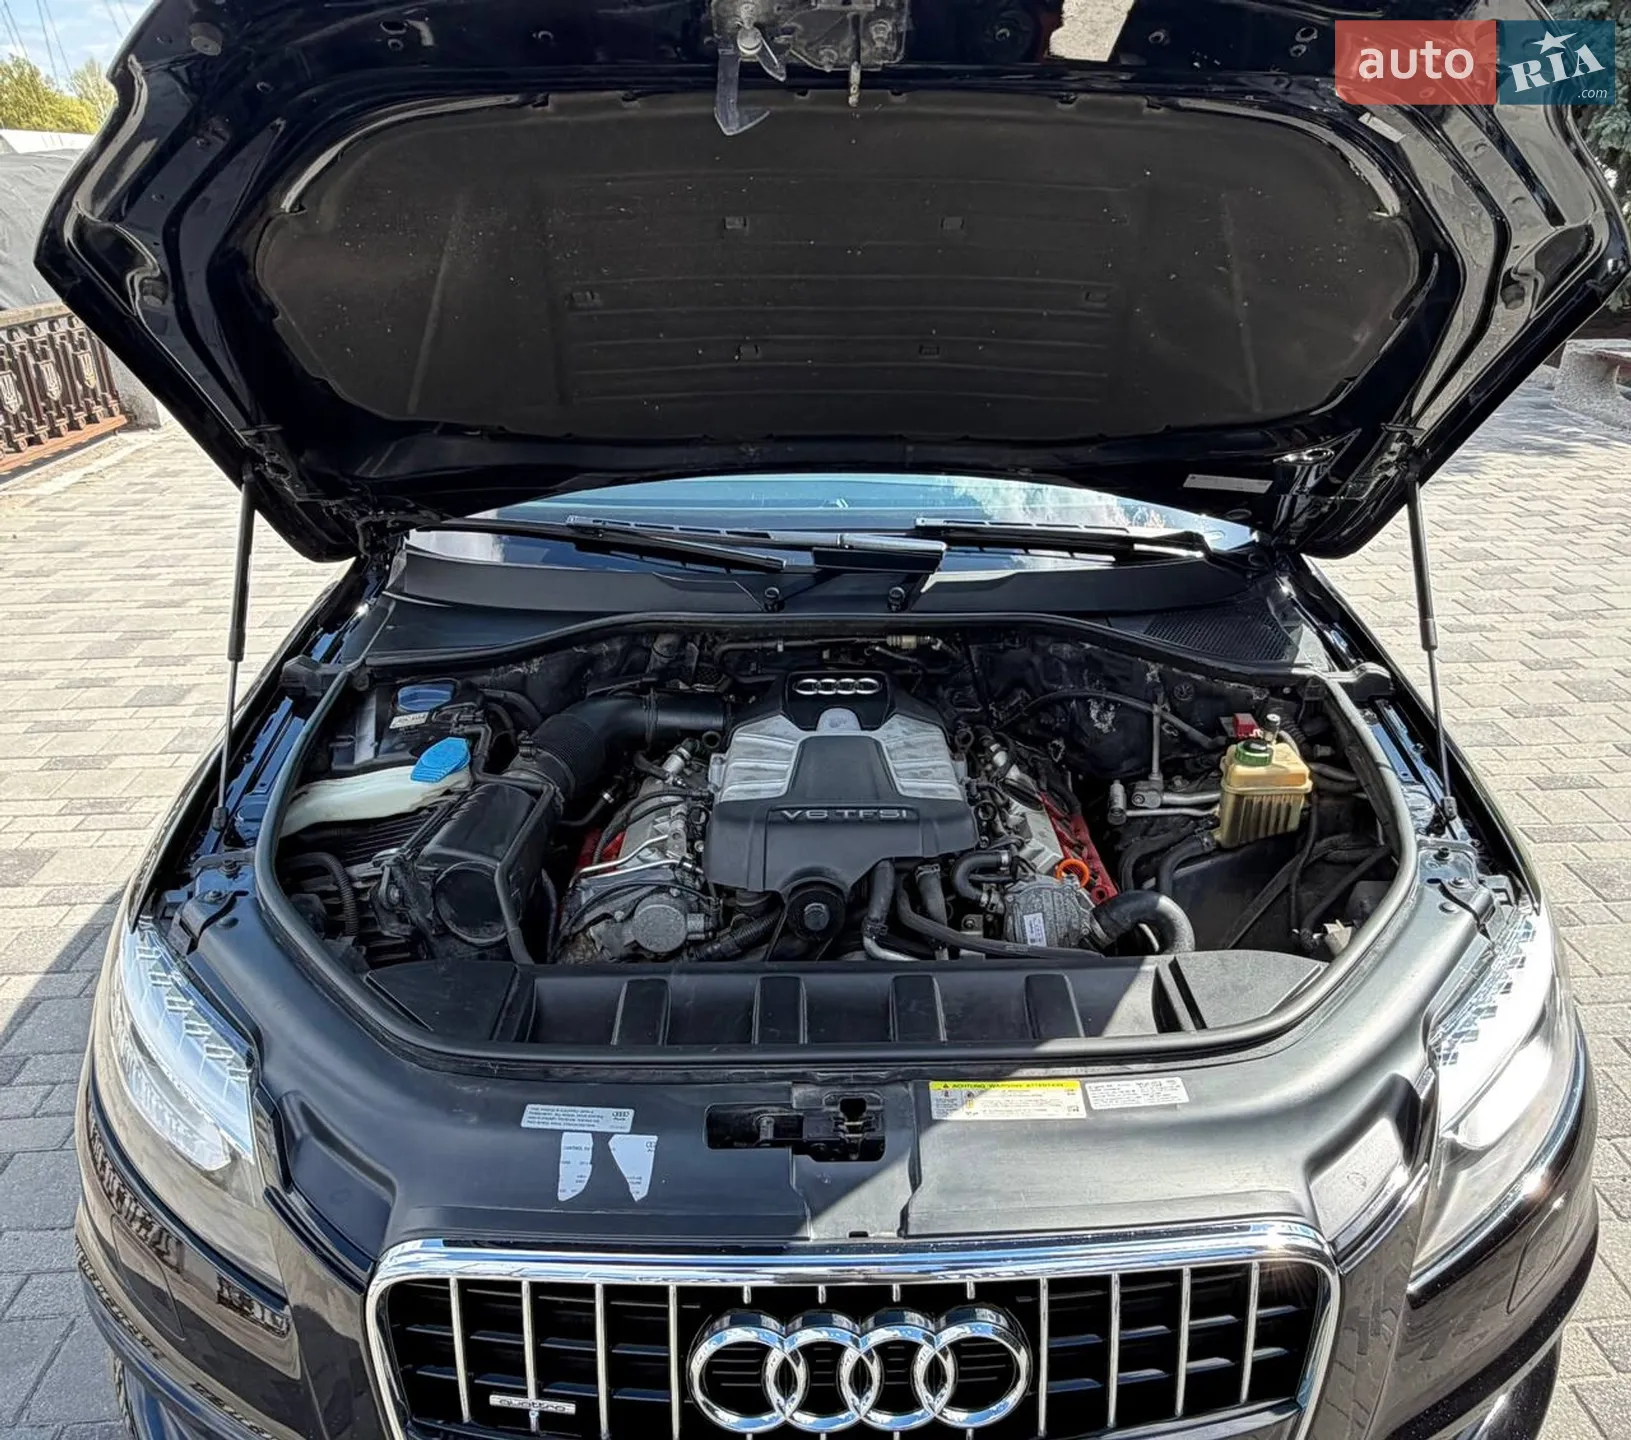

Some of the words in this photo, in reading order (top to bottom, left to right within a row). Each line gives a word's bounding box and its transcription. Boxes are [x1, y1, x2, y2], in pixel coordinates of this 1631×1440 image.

[781, 809, 829, 819] V6
[836, 809, 907, 819] TFSI
[499, 1399, 566, 1412] quattro
